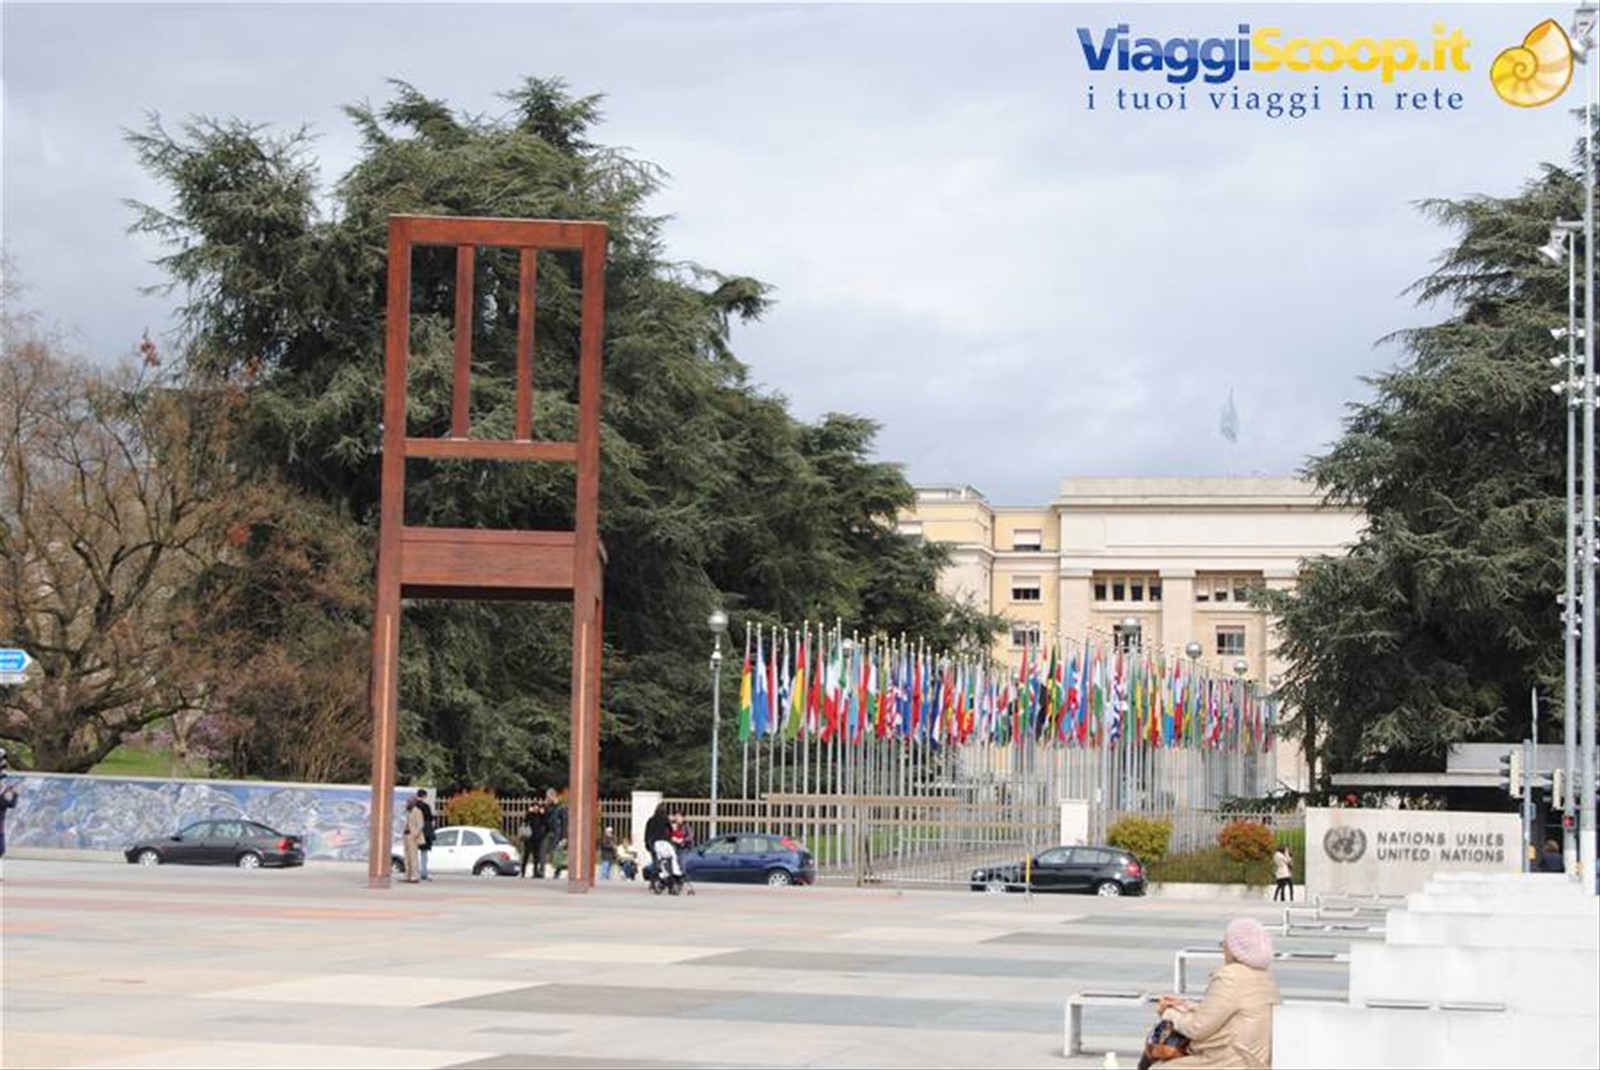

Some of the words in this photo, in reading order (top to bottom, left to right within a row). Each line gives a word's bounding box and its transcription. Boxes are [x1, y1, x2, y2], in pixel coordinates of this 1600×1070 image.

[1376, 831, 1446, 846] NATIONS
[1456, 833, 1505, 847] UNIES
[1376, 848, 1430, 862] UNITED
[1440, 849, 1505, 863] NATIONS
